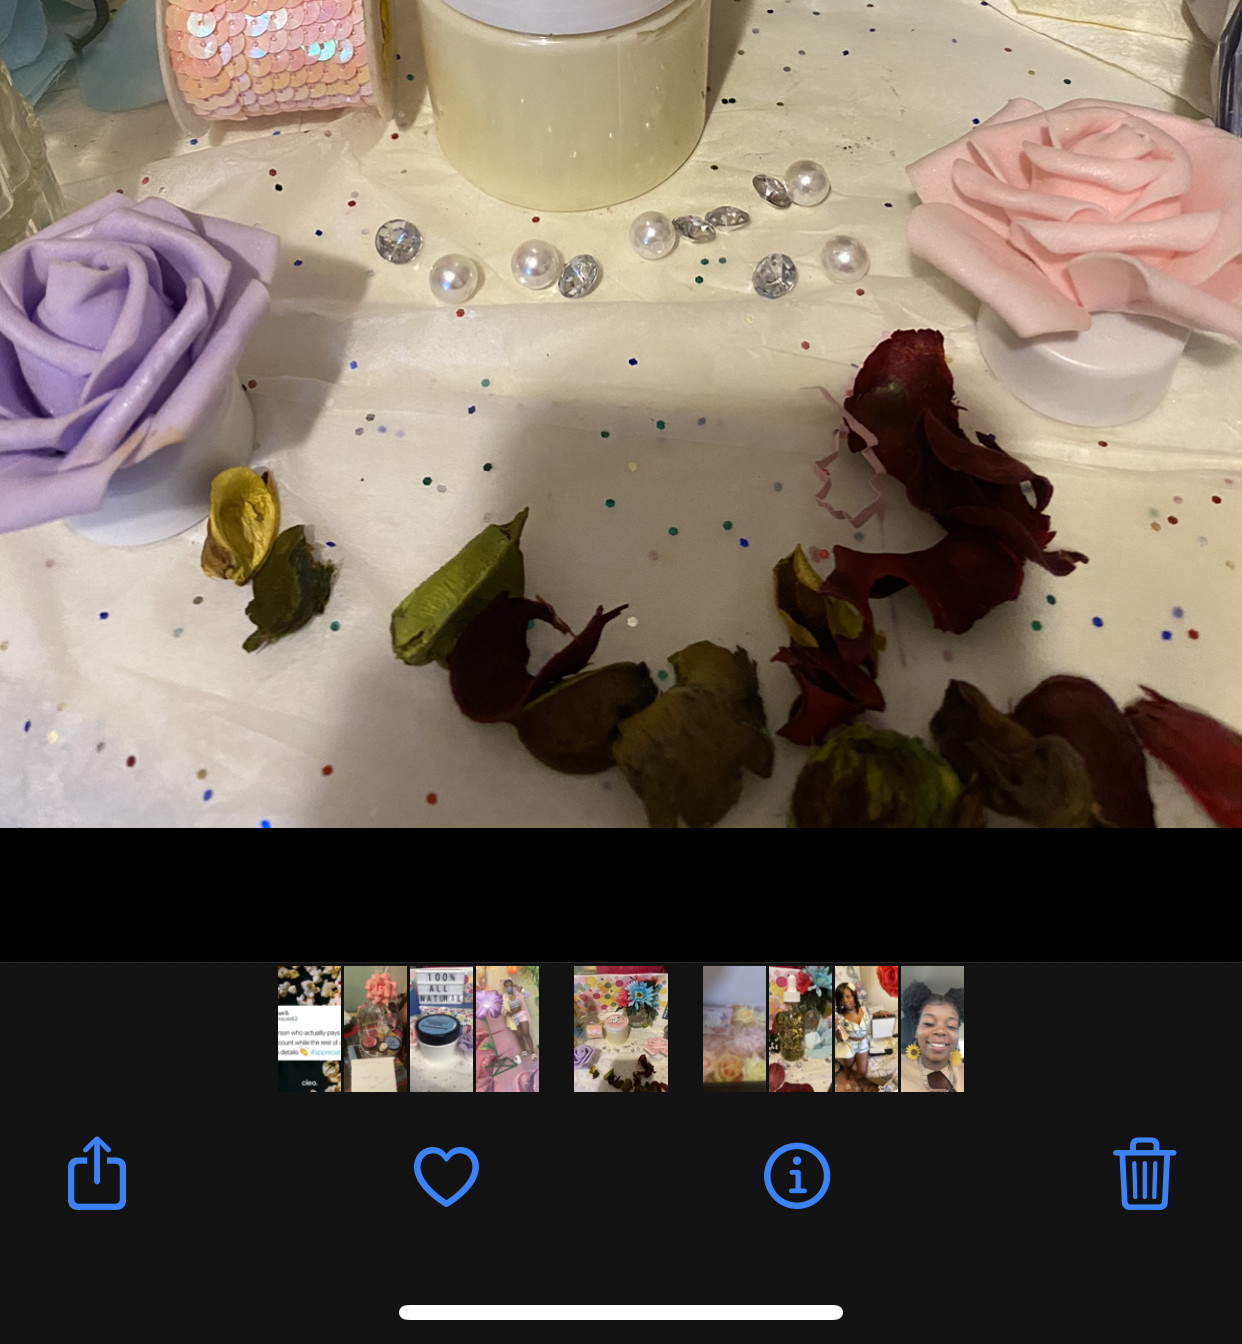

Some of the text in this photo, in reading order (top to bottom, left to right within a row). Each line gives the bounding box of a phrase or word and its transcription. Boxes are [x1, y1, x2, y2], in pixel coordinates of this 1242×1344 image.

[427, 972, 456, 982] 100%
[428, 984, 449, 993] ALL
[420, 994, 462, 1003] NATURAL
